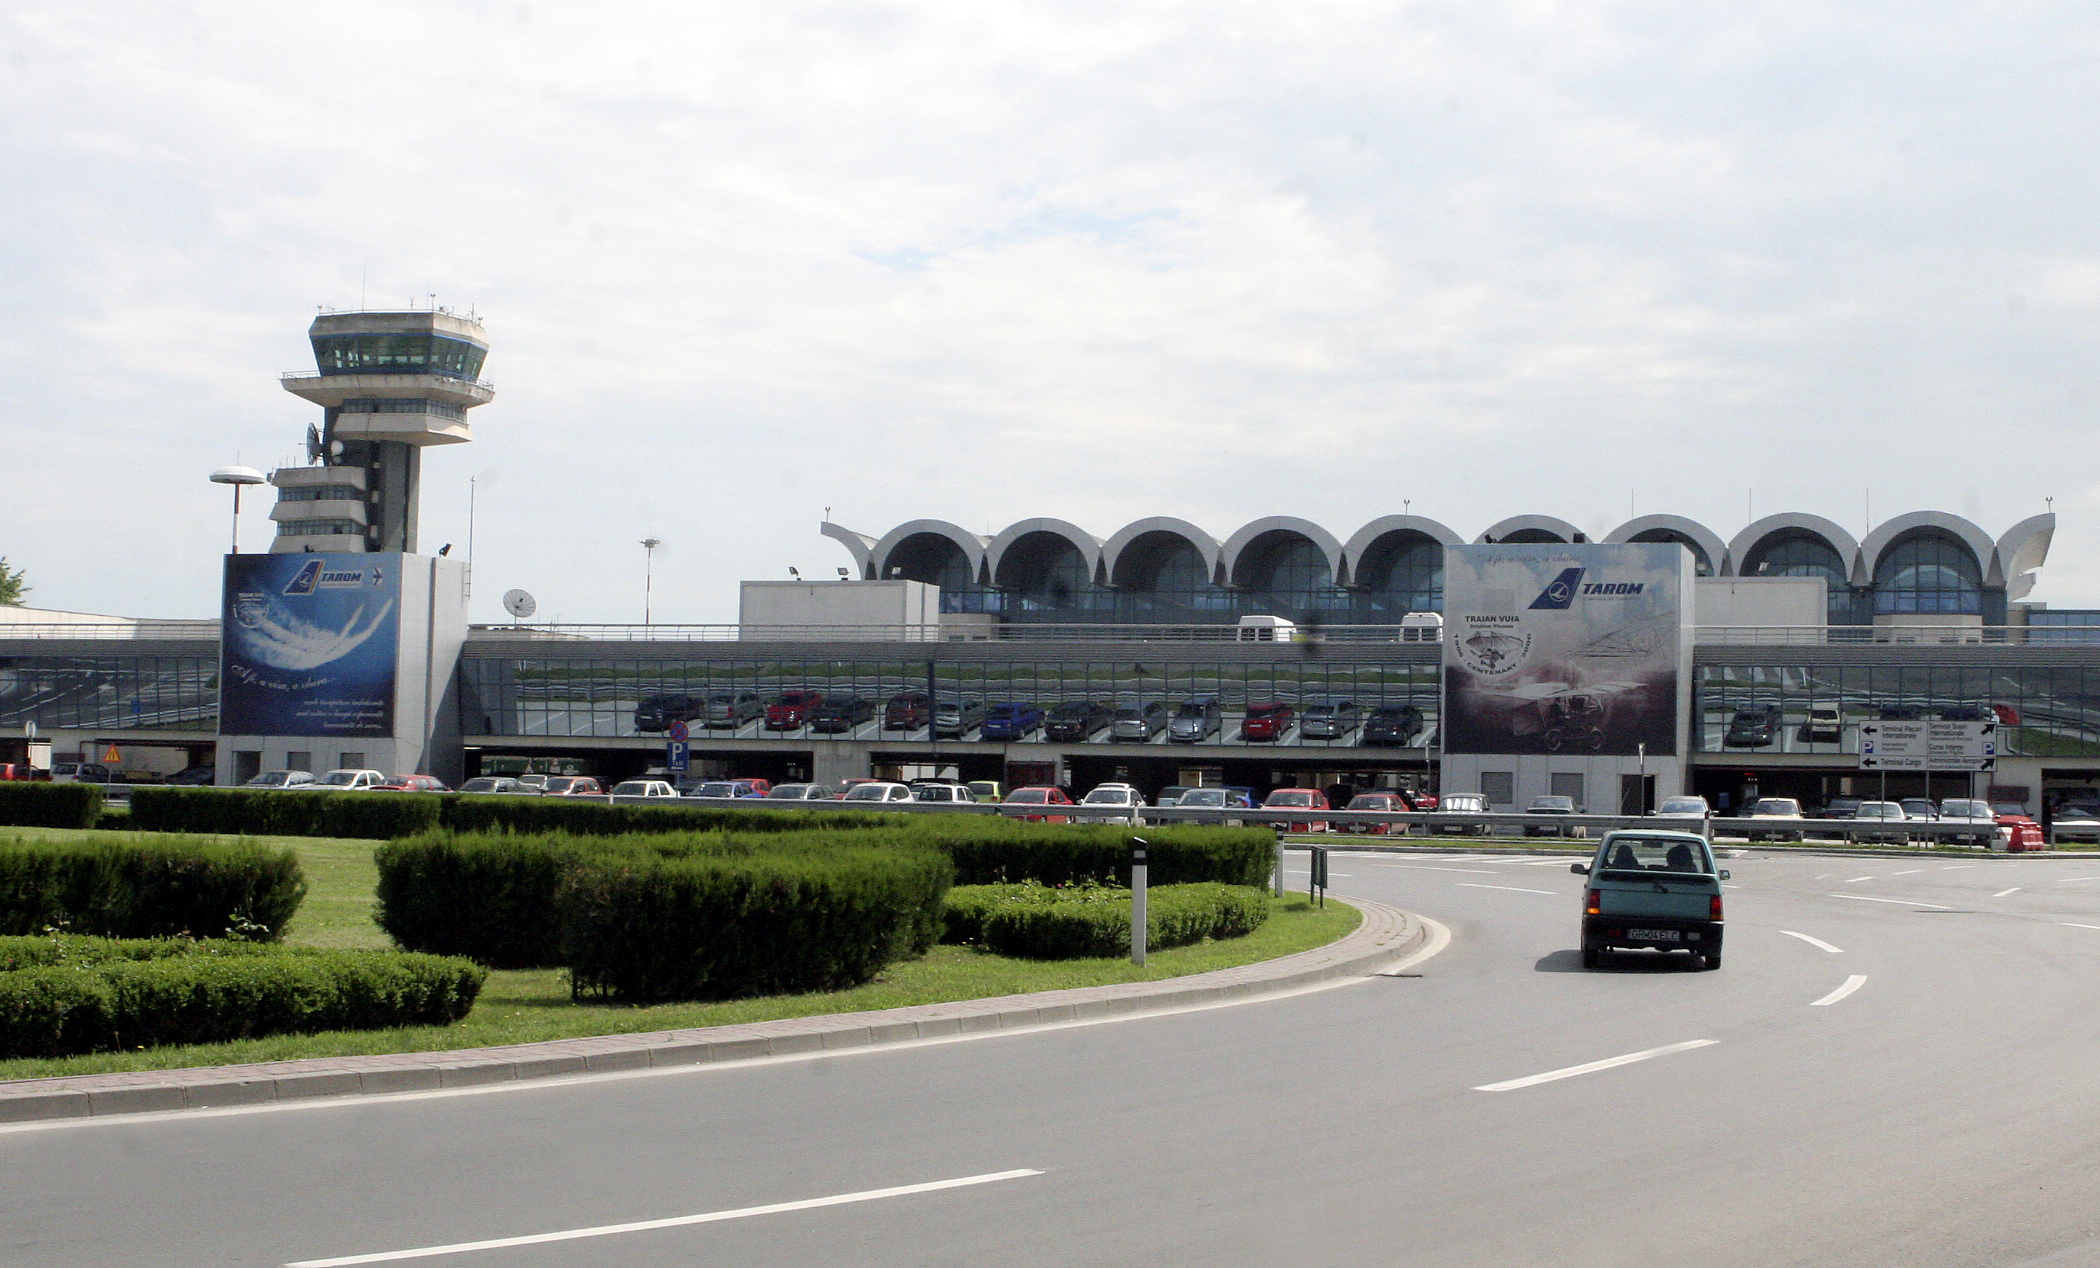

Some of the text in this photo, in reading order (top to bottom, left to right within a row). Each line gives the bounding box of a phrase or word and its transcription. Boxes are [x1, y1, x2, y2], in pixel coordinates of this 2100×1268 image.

[322, 572, 362, 582] TAROM
[1583, 583, 1644, 594] TAROM
[1467, 662, 1517, 676] CENTENARY
[1881, 724, 1904, 732] Terminal
[672, 743, 683, 760] P
[1881, 758, 1921, 767] Terminal Cargo
